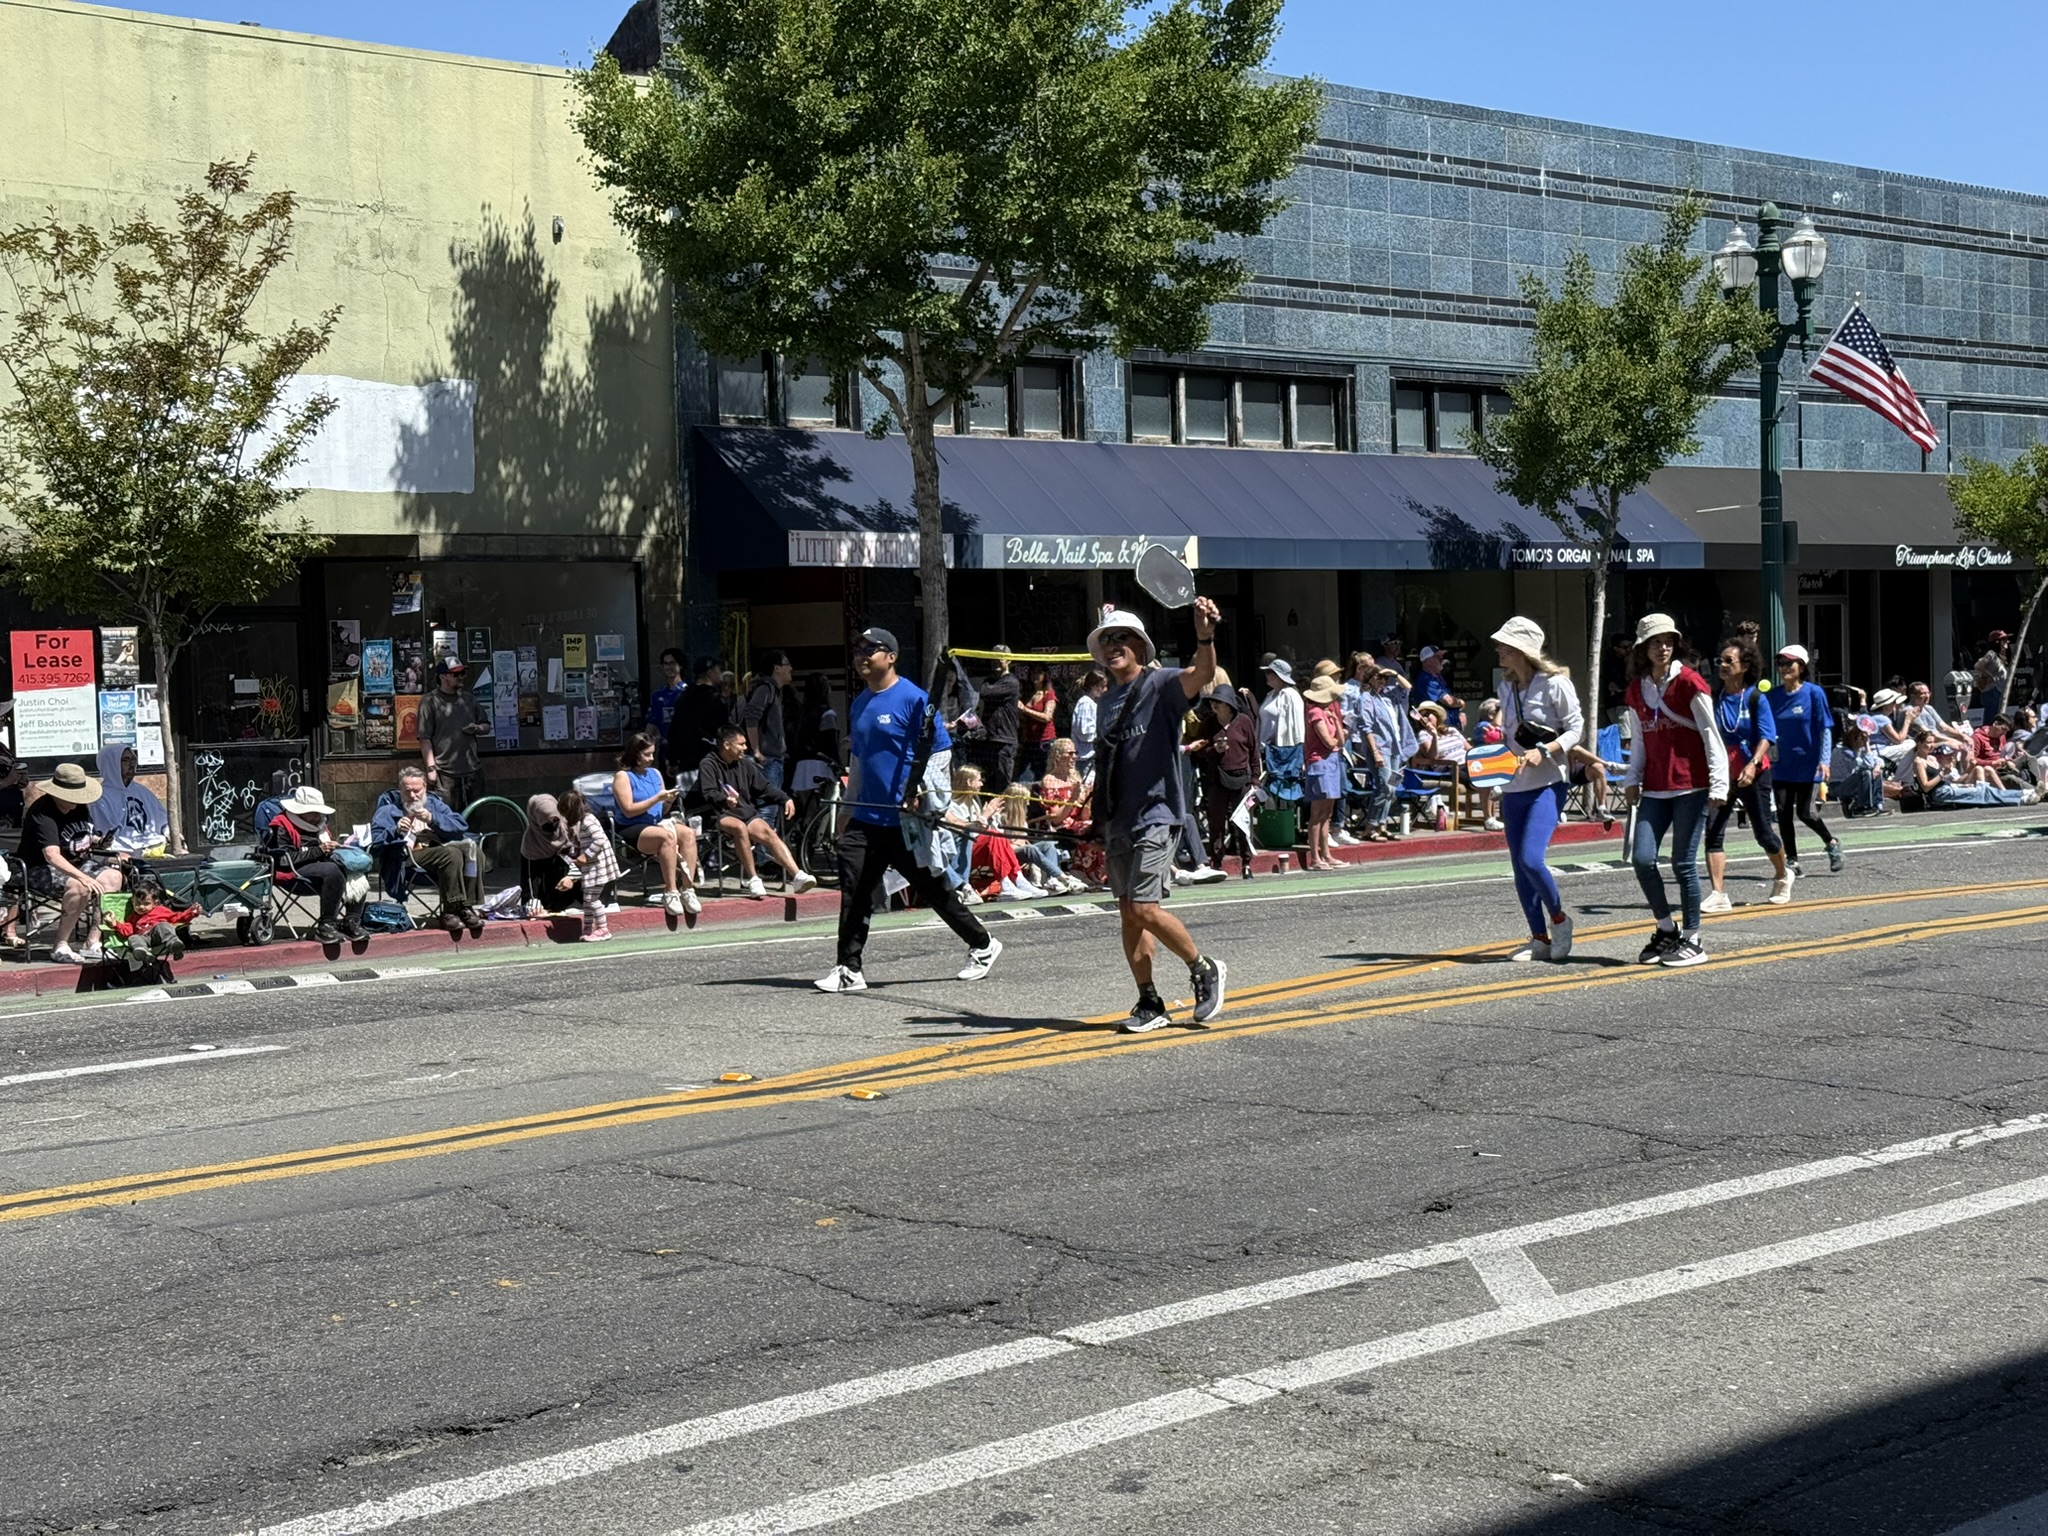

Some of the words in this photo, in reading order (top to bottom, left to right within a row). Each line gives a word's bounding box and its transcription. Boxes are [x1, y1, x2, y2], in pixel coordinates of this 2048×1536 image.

[795, 537, 845, 563] LITTLE
[1005, 537, 1050, 564] Bella
[1050, 538, 1087, 565] Nail
[1088, 541, 1114, 568] Spa
[1117, 539, 1130, 564] &
[1511, 548, 1553, 563] TOMO'S
[1610, 548, 1633, 563] NAIL
[1636, 548, 1655, 563] SPA
[1895, 544, 1956, 568] Triumphant
[1955, 546, 1976, 570] Life
[35, 633, 70, 649] For
[566, 637, 583, 645] IMP
[23, 652, 83, 669] Lease
[18, 672, 90, 684] 415.395.7262
[18, 698, 46, 707] Justin
[18, 719, 36, 728] Jeff
[37, 719, 86, 728] Badstubner
[83, 742, 96, 751] JLL
